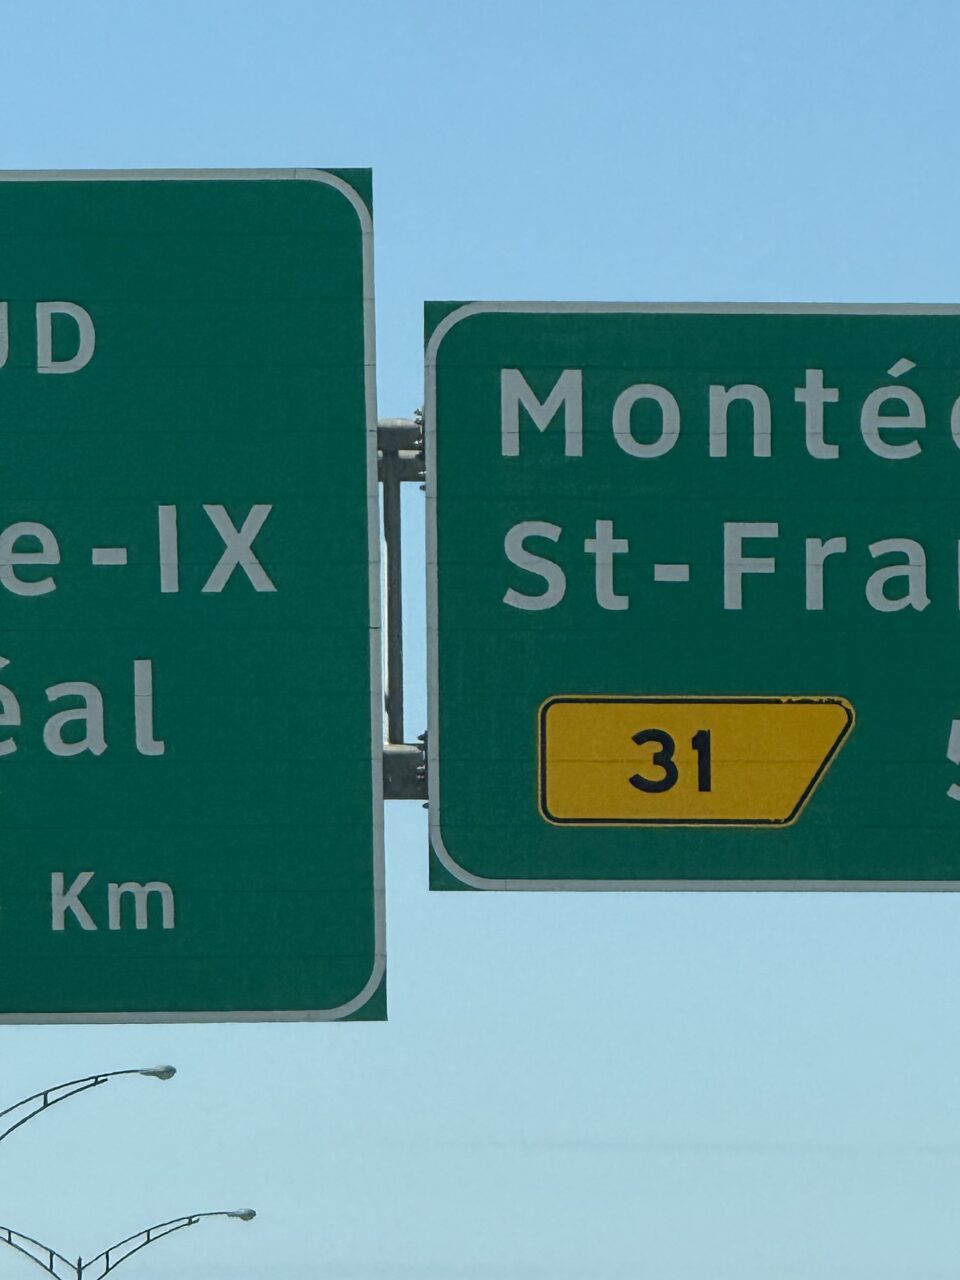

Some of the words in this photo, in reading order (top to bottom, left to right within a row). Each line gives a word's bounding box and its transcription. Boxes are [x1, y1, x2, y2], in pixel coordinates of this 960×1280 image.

[0, 301, 96, 375] D
[628, 728, 711, 792] 31
[51, 871, 174, 931] Km
